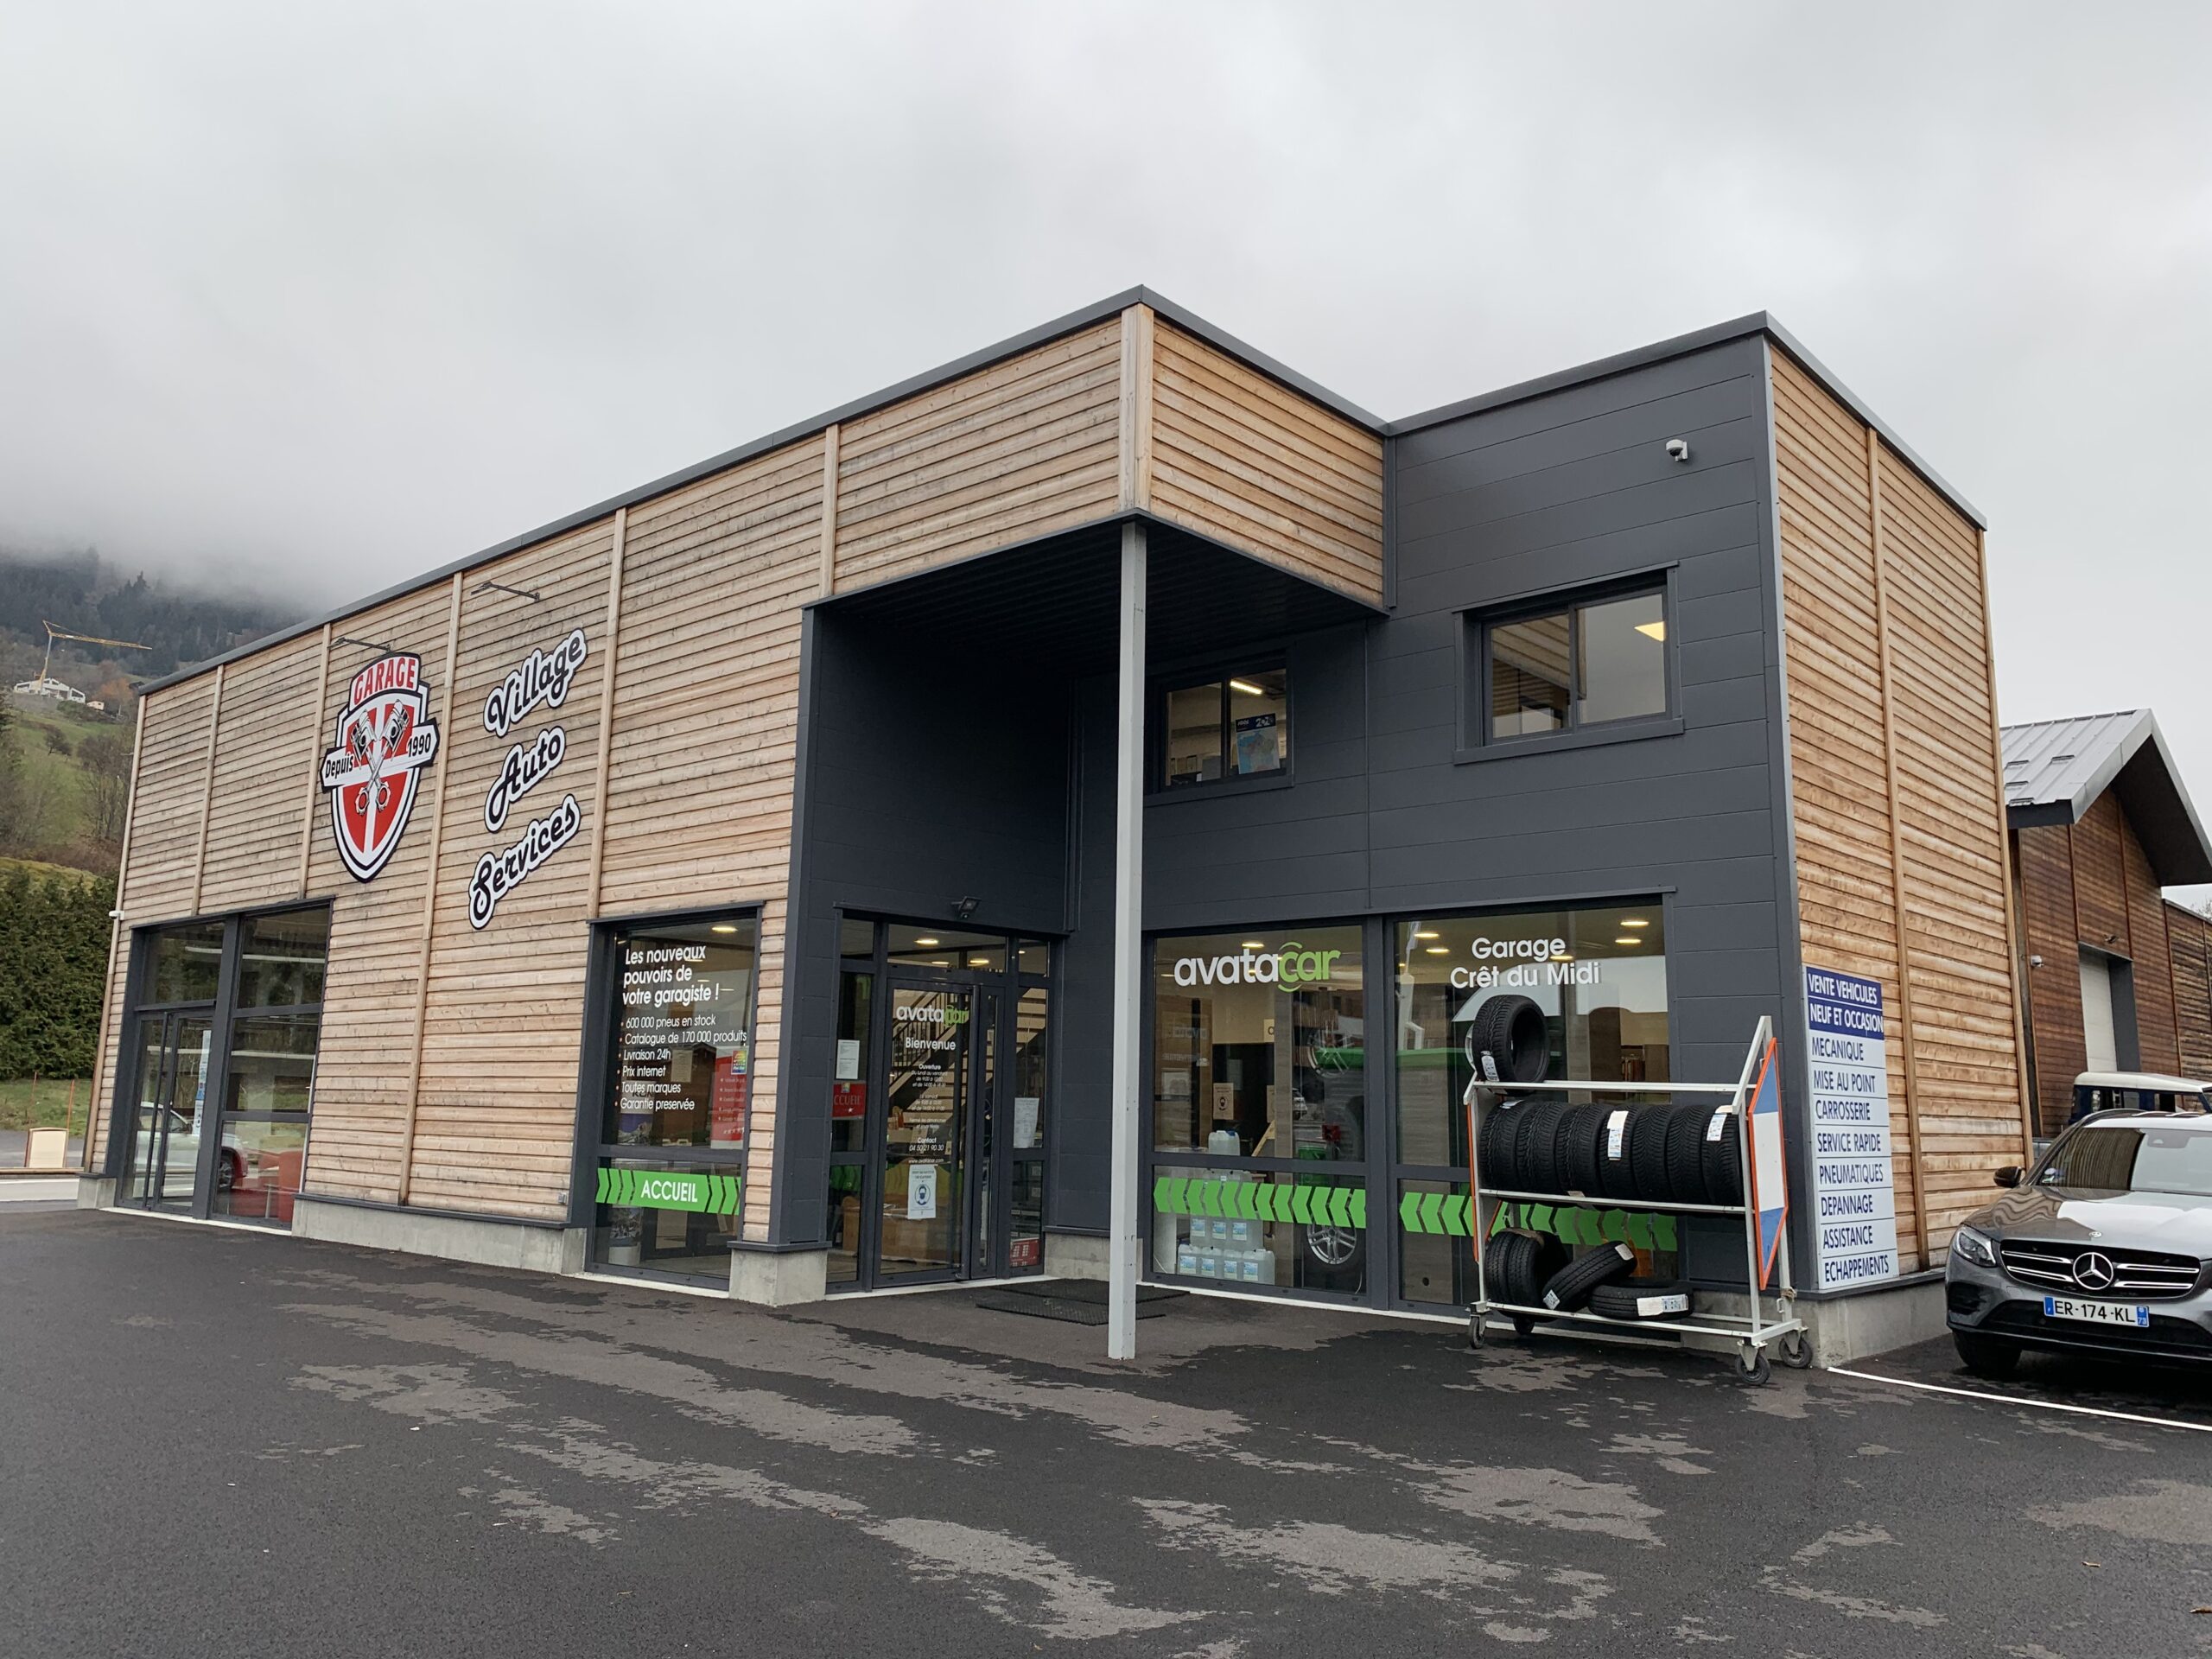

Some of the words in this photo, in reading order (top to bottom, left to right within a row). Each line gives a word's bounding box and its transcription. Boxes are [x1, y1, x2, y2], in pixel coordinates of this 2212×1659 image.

[353, 657, 416, 705] GARAGE
[486, 632, 584, 731] Village
[325, 753, 353, 780] Depuis
[407, 733, 432, 758] 1990
[486, 733, 562, 826] Auto
[472, 801, 576, 922] Services
[625, 948, 644, 965] Les
[646, 945, 707, 963] nouveaux
[1471, 937, 1566, 963] Garage
[623, 968, 673, 988] pouvoirs
[676, 964, 692, 982] de
[1174, 942, 1341, 992] avatacar
[1450, 965, 1500, 988] Crêt
[1507, 964, 1538, 987] du
[1547, 961, 1599, 986] Midi
[622, 988, 652, 1006] votre
[654, 984, 712, 1007] garagiste
[1808, 973, 1834, 995] VENTE
[1836, 979, 1878, 1005] VEHICULES
[626, 1016, 639, 1029] 600
[640, 1015, 654, 1028] 000
[656, 1018, 680, 1030] pneus
[682, 1017, 692, 1027] en
[694, 1014, 716, 1027] stock
[1809, 1003, 1832, 1023] NEUF
[1833, 1007, 1843, 1027] ET
[1844, 1009, 1884, 1033] OCCASION
[625, 1033, 666, 1046] Catalogue
[668, 1032, 679, 1042] de
[682, 1031, 695, 1042] 170
[696, 1031, 711, 1042] 000
[713, 1030, 747, 1044] produits
[905, 1037, 957, 1050] Bienvenue
[1812, 1037, 1864, 1060] MECANIQUE
[623, 1050, 655, 1061] Livraison
[657, 1049, 671, 1060] 24h
[622, 1065, 636, 1077] Prix
[636, 1065, 666, 1077] internet
[1814, 1070, 1834, 1090] MISE
[1836, 1072, 1848, 1091] AU
[1852, 1073, 1875, 1093] POINT
[621, 1081, 645, 1093] Toutes
[647, 1083, 681, 1096] marques
[620, 1097, 654, 1110] Garantie
[1815, 1099, 1871, 1121] CARROSSERIE
[1817, 1133, 1852, 1153] SERVICE
[1854, 1133, 1881, 1152] RAPIDE
[1819, 1163, 1884, 1185] PNEUMATIQUES
[640, 1179, 698, 1203] ACCUEIL
[1821, 1194, 1873, 1216] DEPANNAGE
[1823, 1225, 1873, 1249] ASSISTANCE
[1825, 1255, 1890, 1282] ECHAPPEMENTS
[2055, 1300, 2136, 1323] ER-174-KL
[2138, 1316, 2147, 1325] 73
